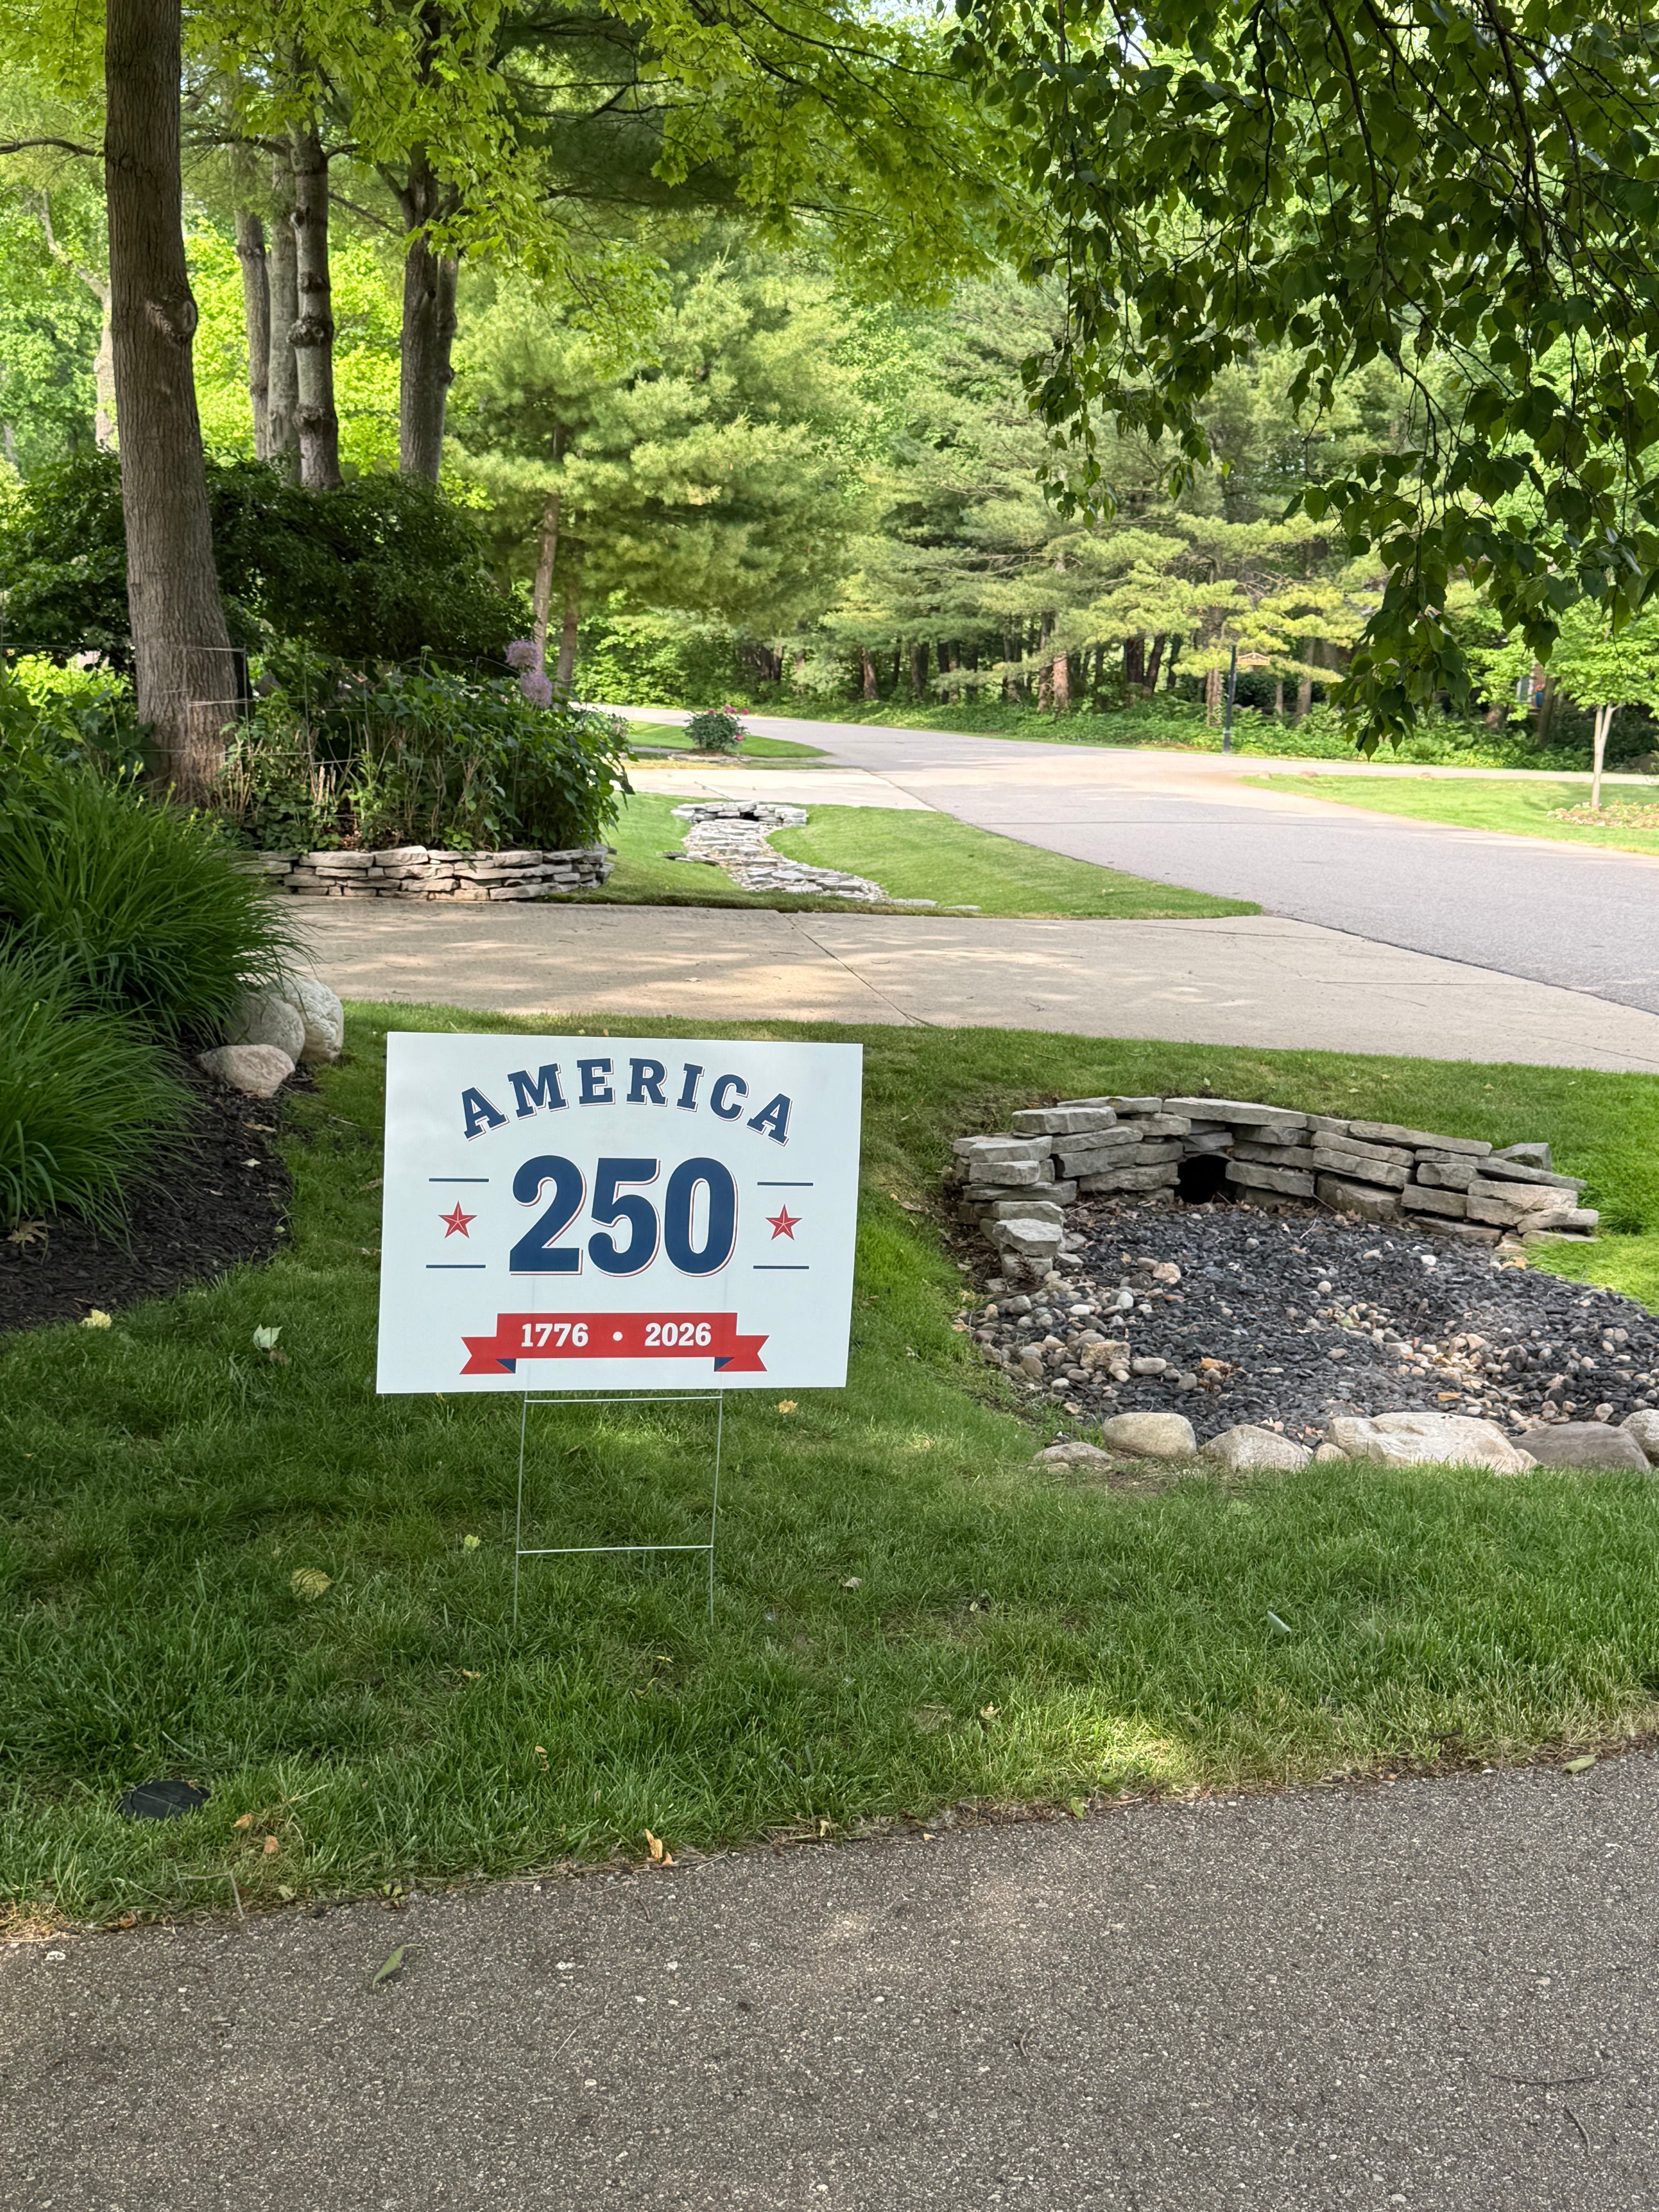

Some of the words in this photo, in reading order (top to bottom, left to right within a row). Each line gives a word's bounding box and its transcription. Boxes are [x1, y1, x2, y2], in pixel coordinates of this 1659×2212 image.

[461, 1058, 795, 1147] AMERICA
[509, 1155, 739, 1277] 250
[520, 1322, 589, 1348] 1776
[644, 1322, 712, 1347] 2026
